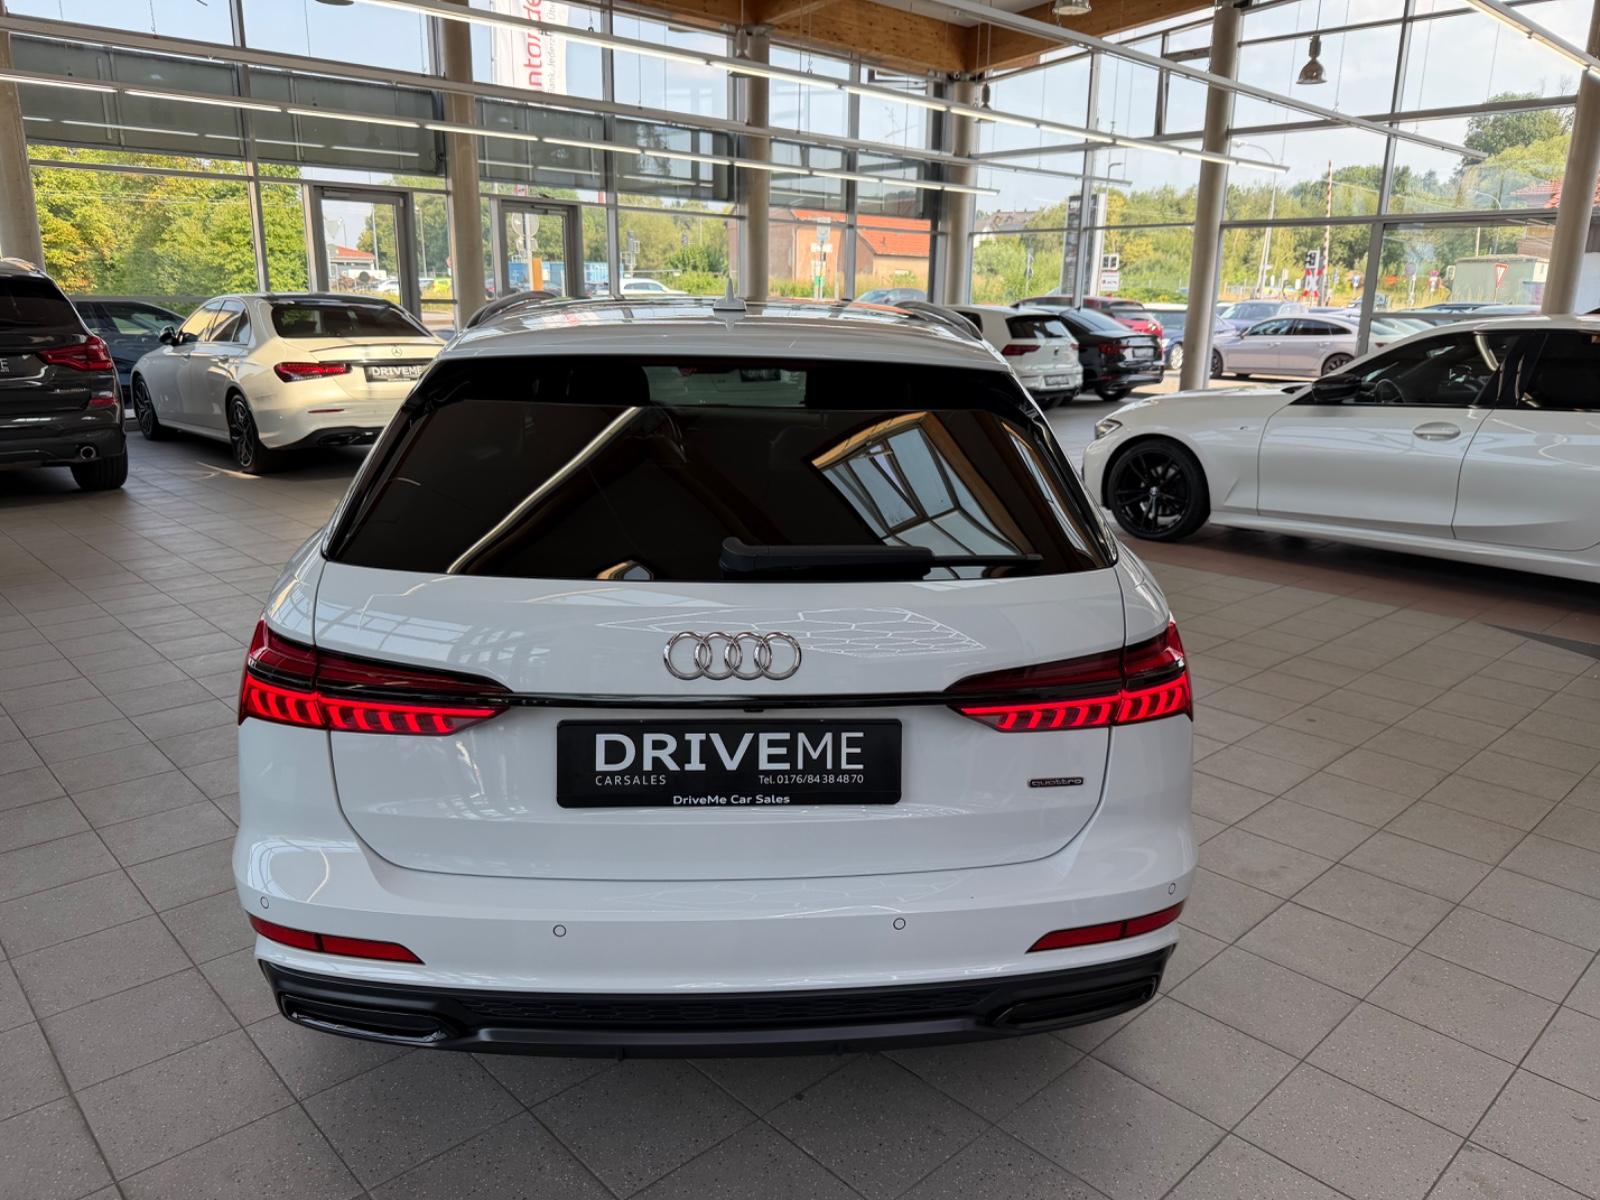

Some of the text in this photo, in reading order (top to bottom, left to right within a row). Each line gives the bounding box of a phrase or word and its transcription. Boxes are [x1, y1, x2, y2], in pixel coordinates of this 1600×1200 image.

[372, 365, 423, 375] DRIVEME
[595, 732, 864, 771] DRIVEME
[595, 775, 666, 786] CARSALES
[758, 775, 775, 784] Tel.
[672, 794, 790, 805] DriveMe Car Sales
